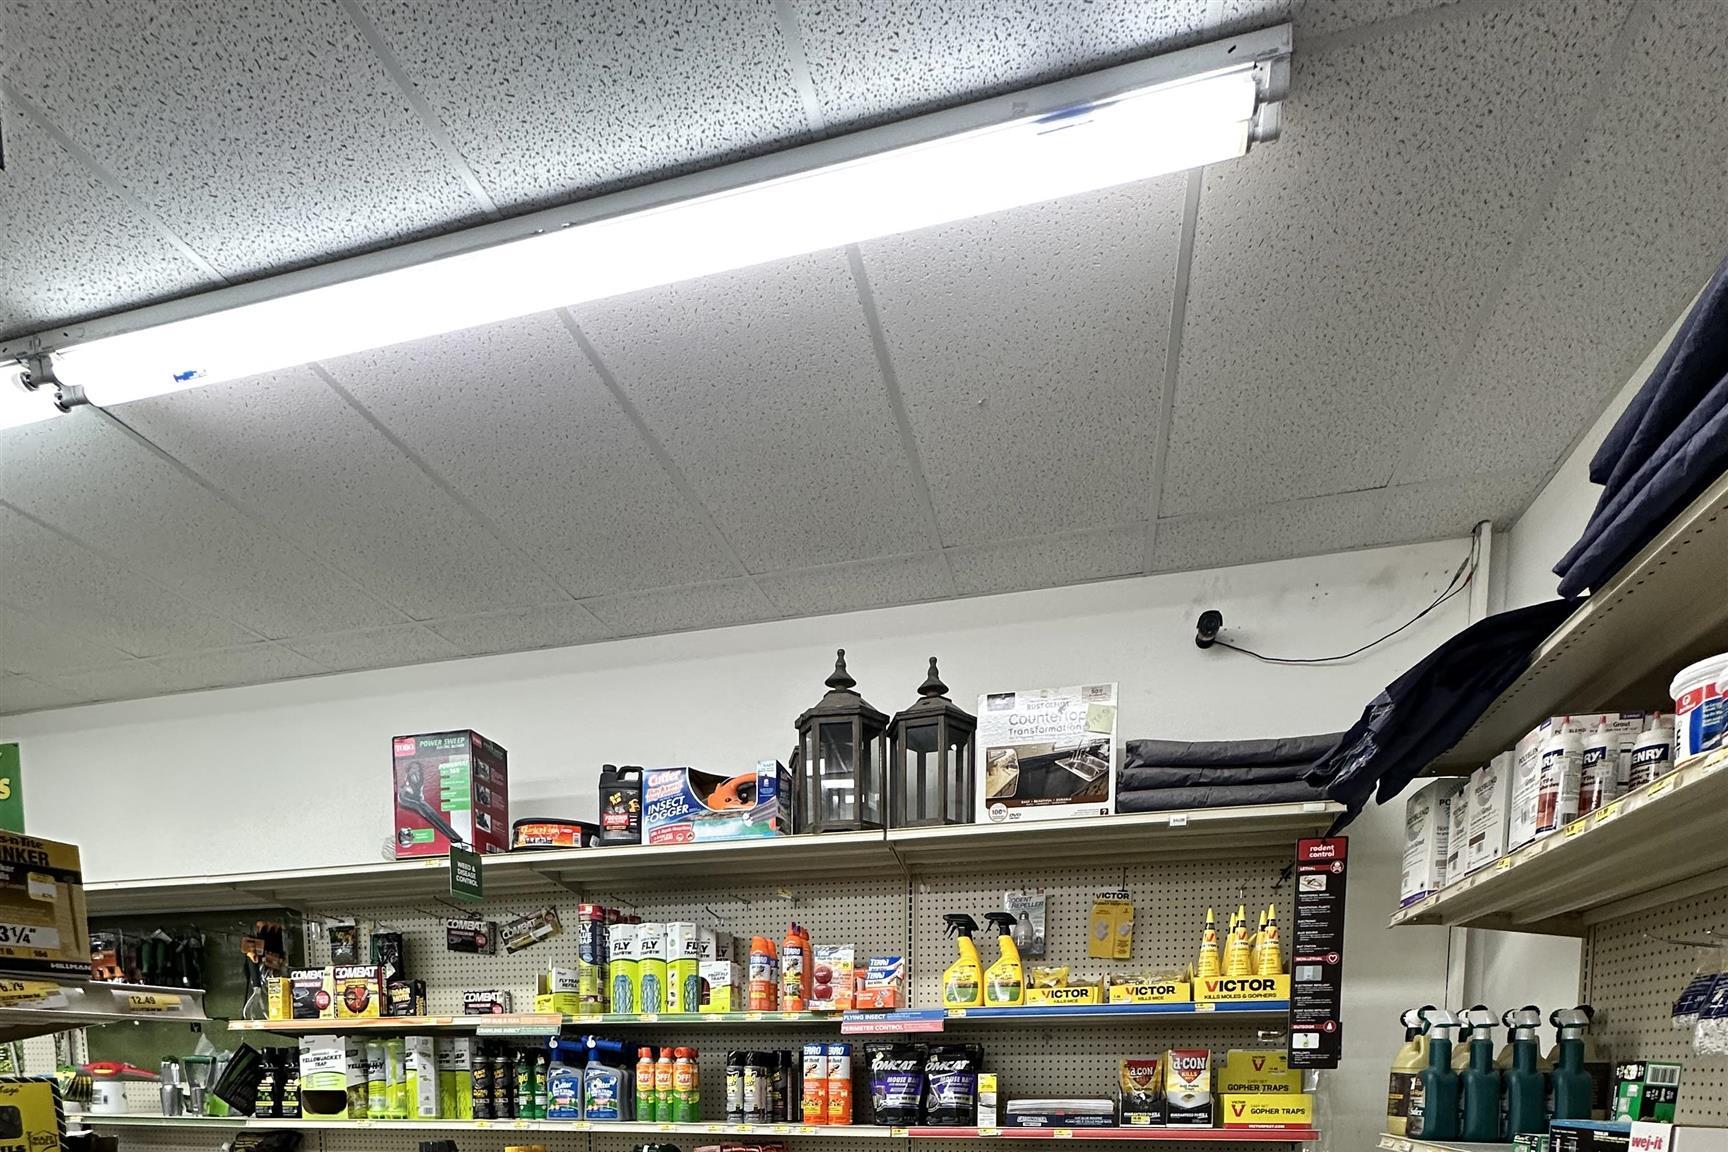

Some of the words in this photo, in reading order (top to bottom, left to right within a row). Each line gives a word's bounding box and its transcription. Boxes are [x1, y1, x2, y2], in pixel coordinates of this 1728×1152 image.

[419, 738, 442, 747] POWER
[443, 736, 465, 746] SWEEP
[1632, 748, 1664, 764] ENRY
[647, 796, 685, 815] INSECT
[645, 805, 689, 823] FOGGER
[1309, 844, 1335, 852] rodent
[1309, 850, 1335, 858] control
[457, 861, 471, 871] WEED
[457, 868, 477, 880] DISEASE
[456, 875, 478, 887] CONTROL
[1096, 892, 1129, 900] VICTOR
[447, 919, 486, 931] COMBAT
[502, 918, 537, 940] COMBAT
[614, 941, 630, 951] FLY
[641, 940, 658, 950] FLY
[336, 966, 378, 979] COMBAT
[1126, 986, 1176, 996] VICTOR
[1205, 979, 1276, 993] VICTOR
[464, 991, 503, 1002] COMBAT
[1042, 988, 1089, 999] VICTOR
[1173, 1057, 1206, 1069] d-CON
[1227, 1084, 1260, 1092] GOPHER
[1262, 1084, 1289, 1092] TRAPS
[1632, 1136, 1663, 1151] wej-it
